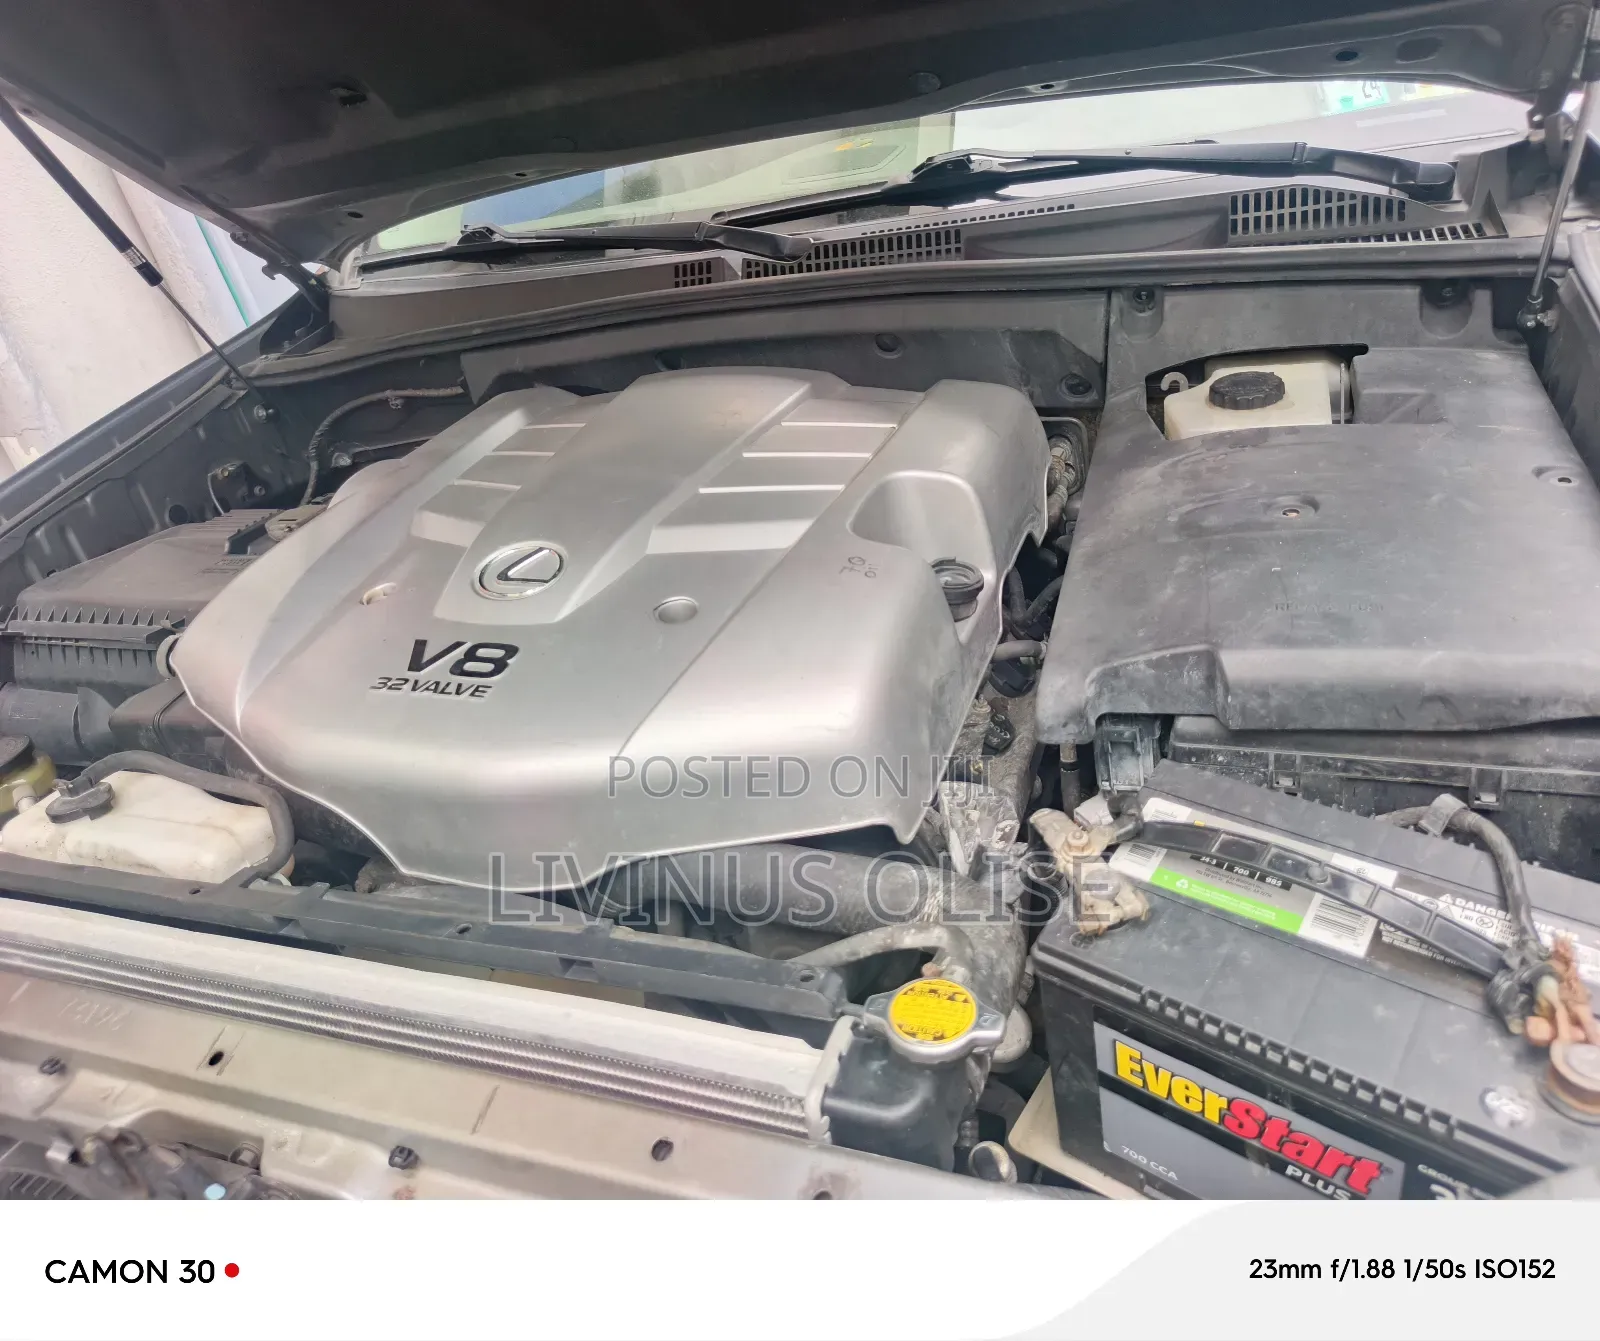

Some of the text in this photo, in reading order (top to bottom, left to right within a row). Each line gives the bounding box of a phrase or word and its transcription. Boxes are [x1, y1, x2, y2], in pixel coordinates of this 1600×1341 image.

[407, 639, 520, 679] V8
[1113, 1038, 1383, 1196] EverStart
[1121, 1145, 1179, 1181] 700 CCA
[1285, 1164, 1352, 1199] PLUS
